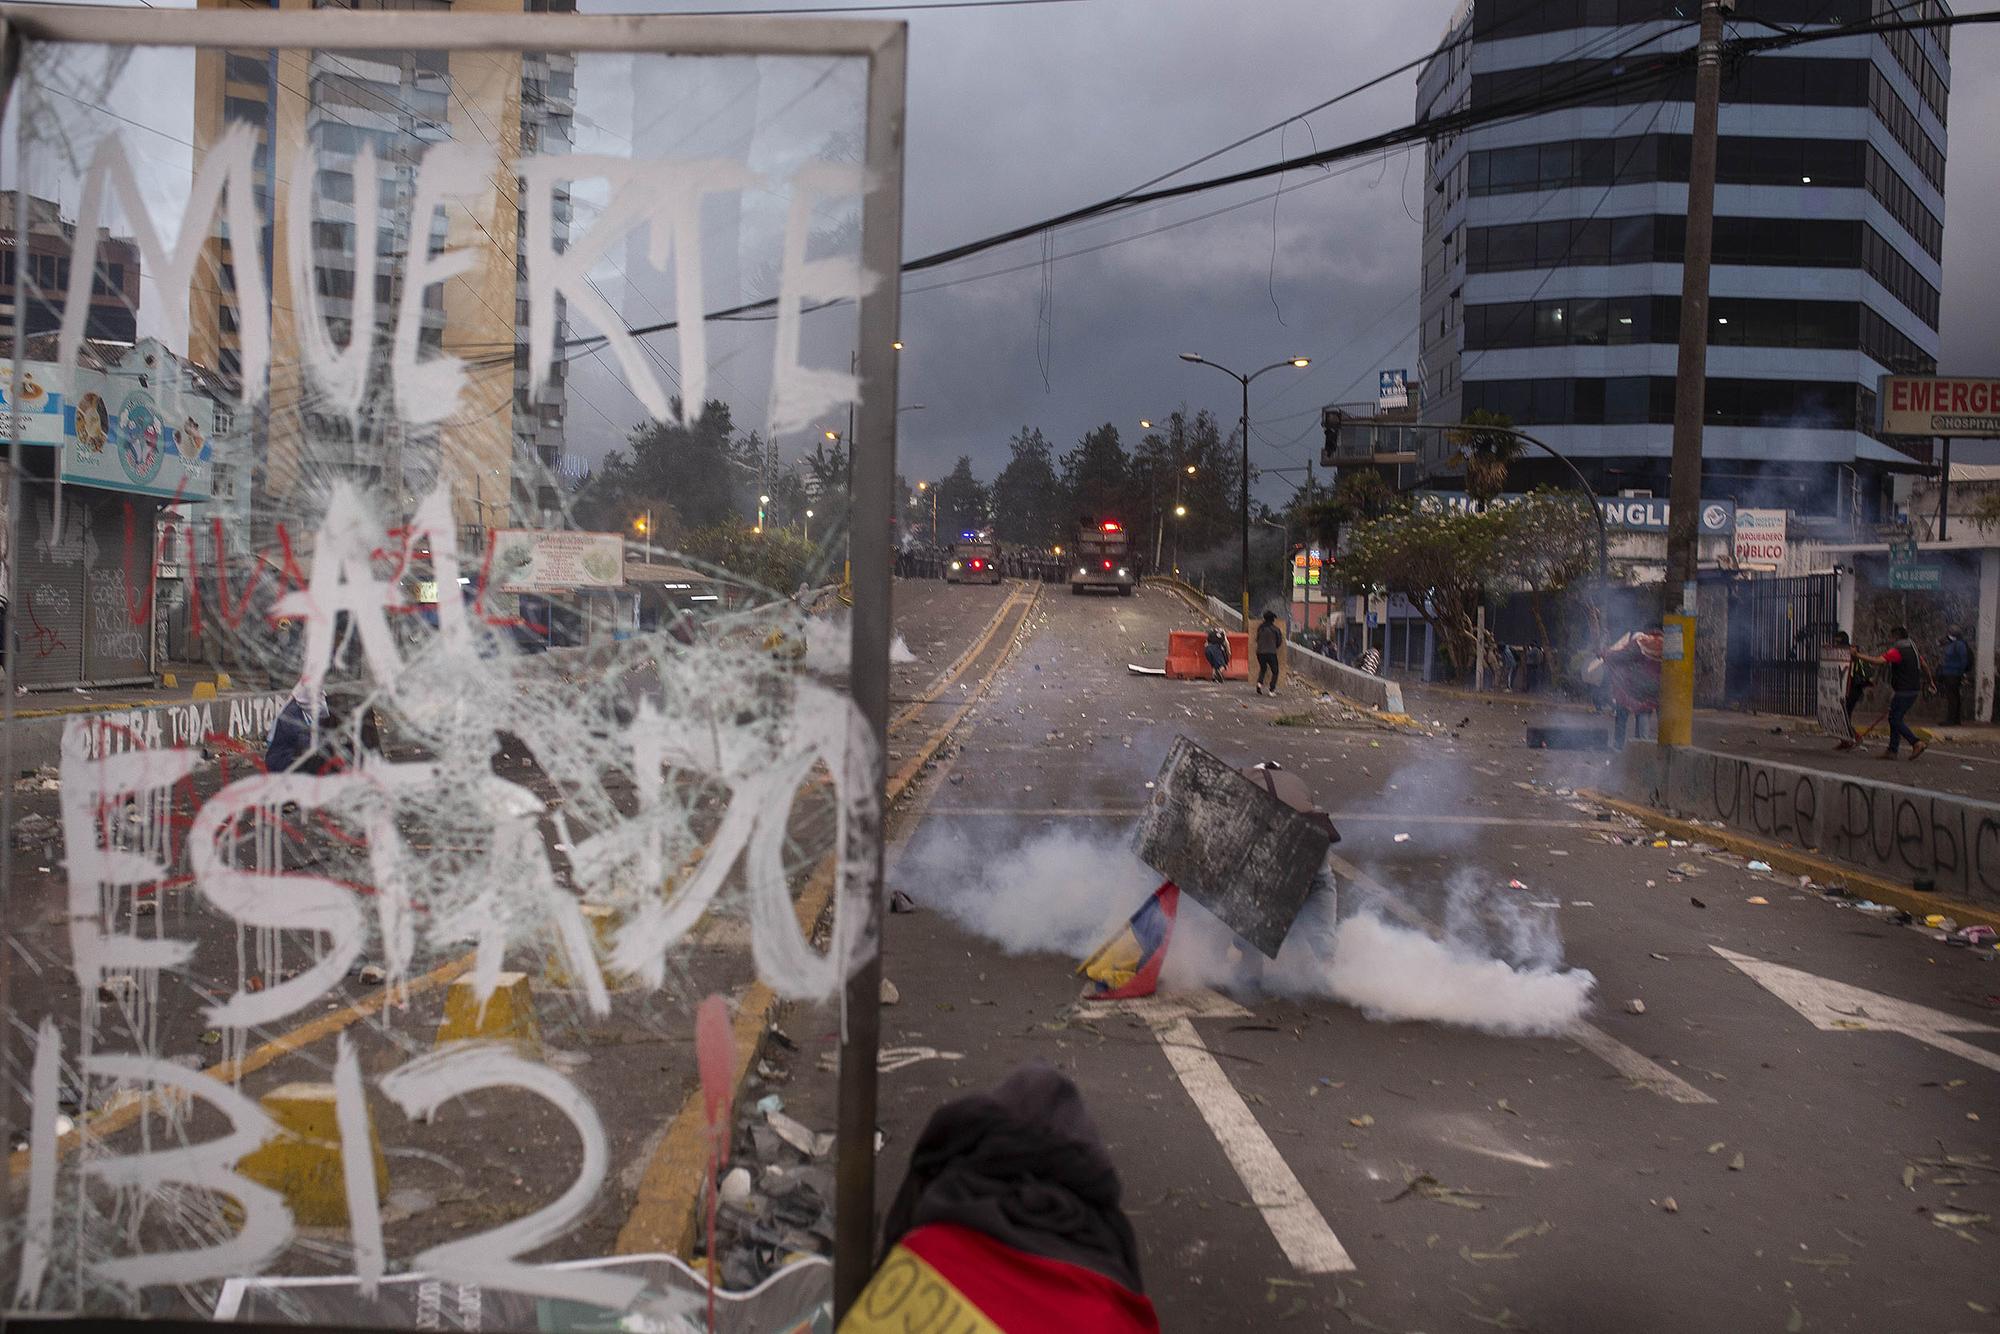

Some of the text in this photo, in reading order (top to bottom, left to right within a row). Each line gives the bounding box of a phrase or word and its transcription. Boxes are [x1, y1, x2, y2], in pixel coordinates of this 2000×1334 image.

[57, 120, 884, 434] MUERTE
[1737, 533, 1783, 541] PARQUEADERO
[168, 703, 215, 746] TODA
